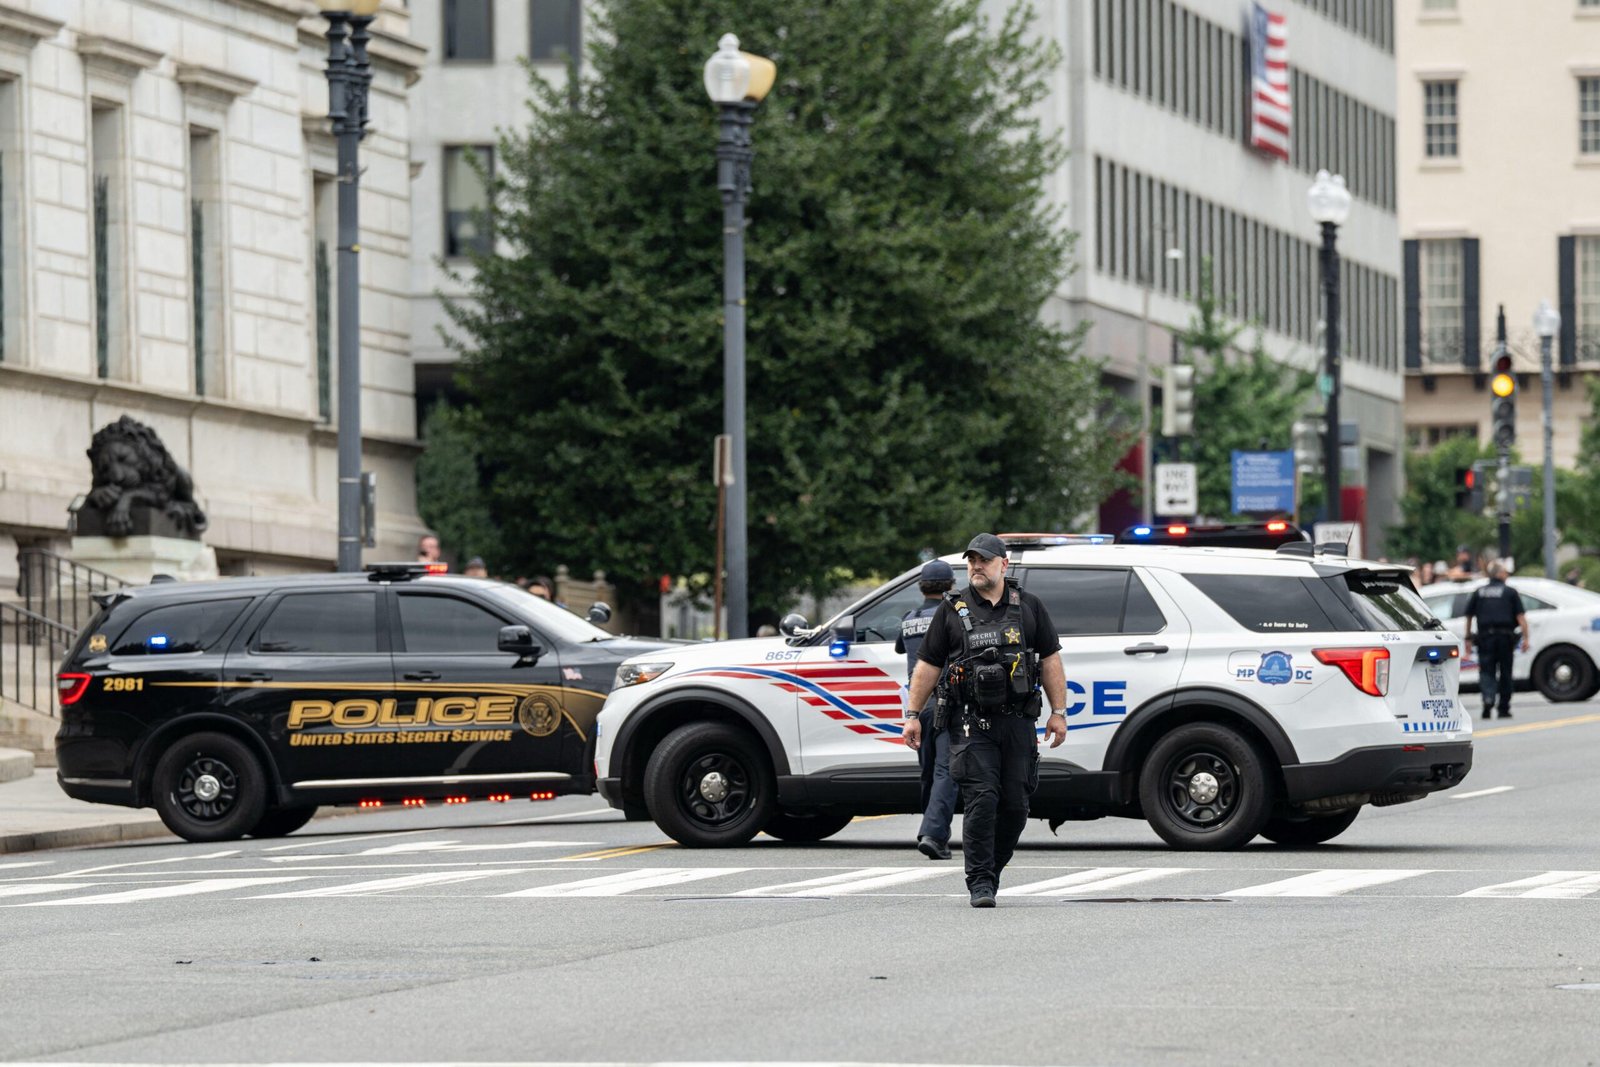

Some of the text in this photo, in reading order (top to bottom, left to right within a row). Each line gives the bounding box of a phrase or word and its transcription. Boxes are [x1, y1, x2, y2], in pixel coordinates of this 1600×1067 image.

[902, 625, 930, 637] POLIC
[970, 631, 998, 641] SECRET
[971, 638, 1001, 648] SERVICE
[765, 650, 802, 661] 8657
[1236, 668, 1255, 678] MP
[1295, 670, 1313, 680] DC
[103, 677, 144, 691] 2981
[287, 696, 517, 729] POLICE
